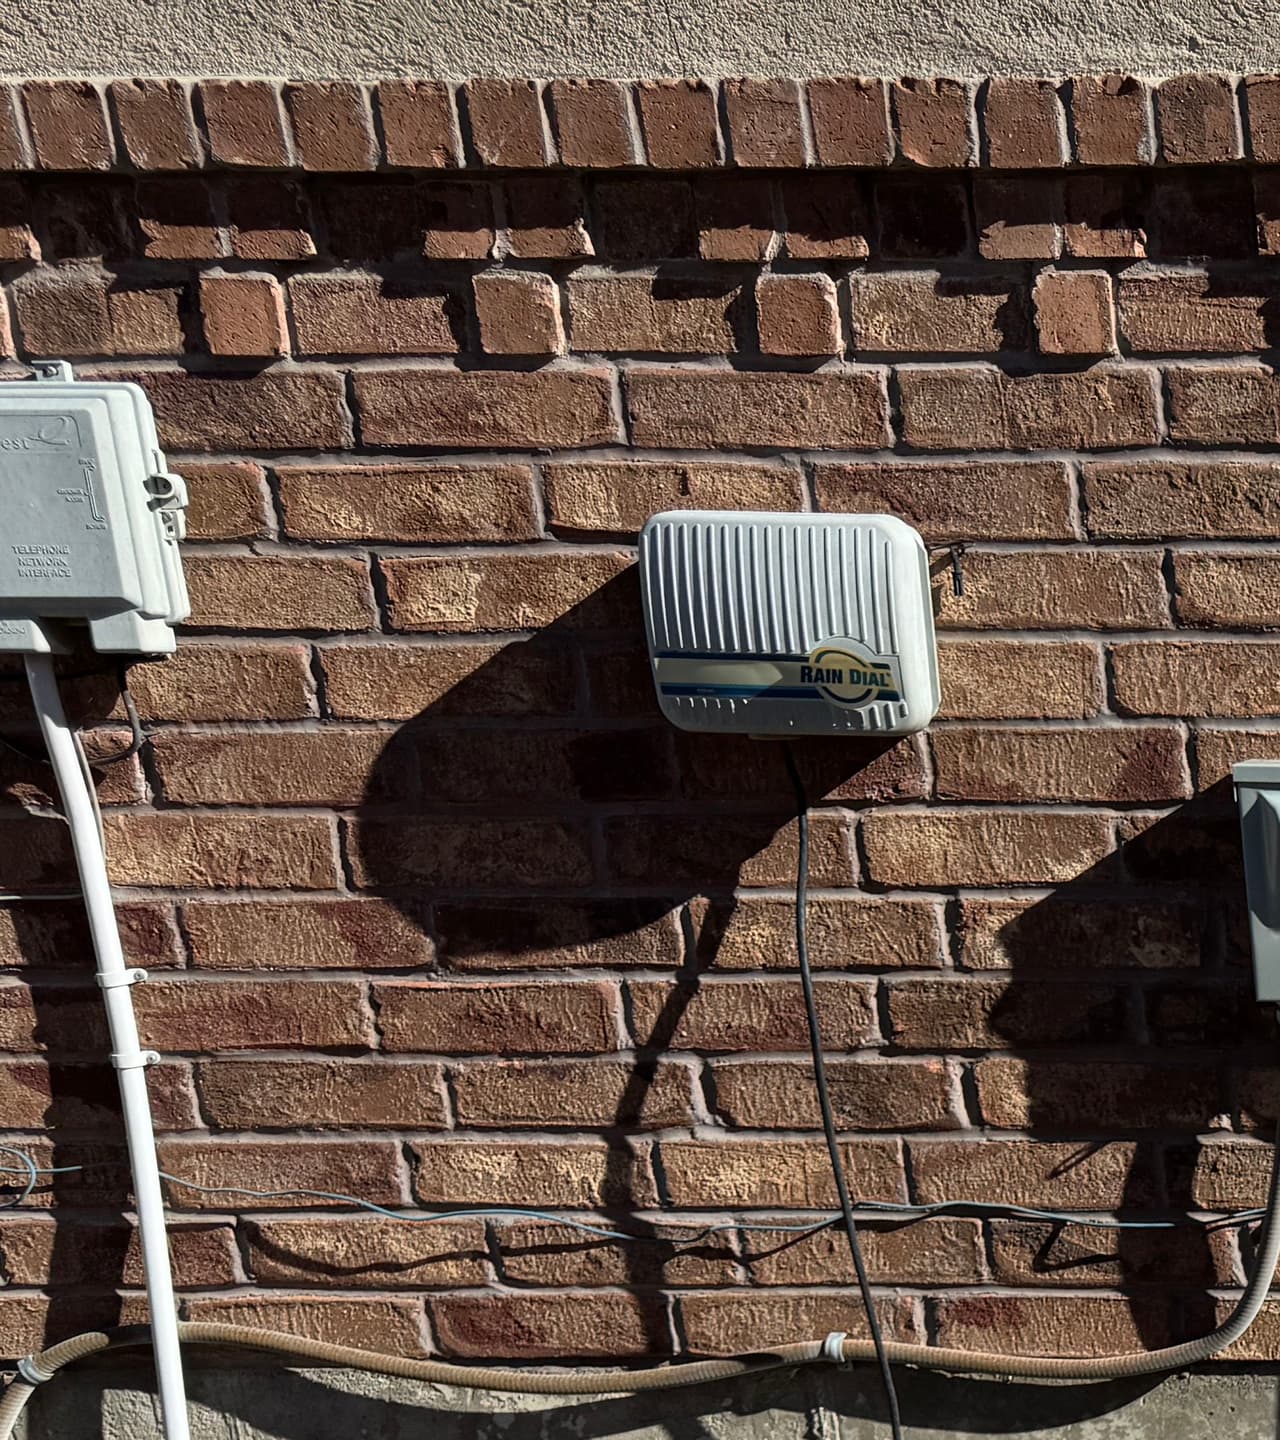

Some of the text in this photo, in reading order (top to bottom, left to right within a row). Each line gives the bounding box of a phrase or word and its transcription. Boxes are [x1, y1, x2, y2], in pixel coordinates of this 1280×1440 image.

[12, 544, 70, 555] TELEPHONE
[17, 556, 68, 567] NETWORK
[18, 568, 72, 578] INTERFACE
[800, 665, 889, 687] RAIN DIAL
